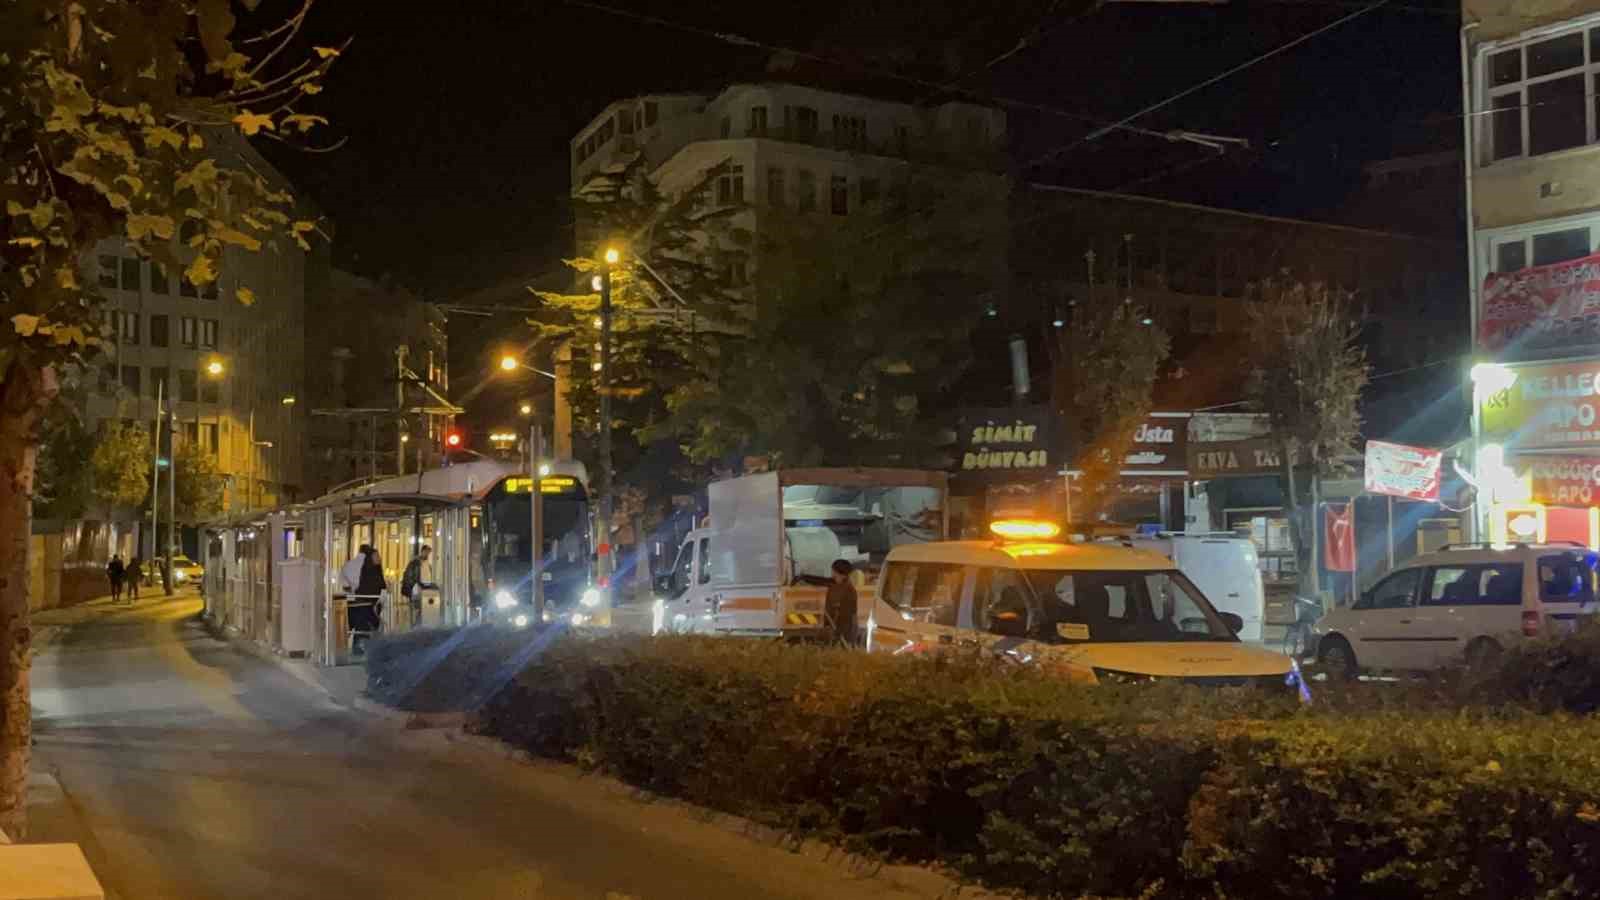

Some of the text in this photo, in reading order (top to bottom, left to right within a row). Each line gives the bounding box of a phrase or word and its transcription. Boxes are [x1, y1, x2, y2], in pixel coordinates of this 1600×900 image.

[971, 419, 1037, 444] SİMİT
[961, 447, 1048, 470] DÜNYASI
[1558, 485, 1593, 504] APO
